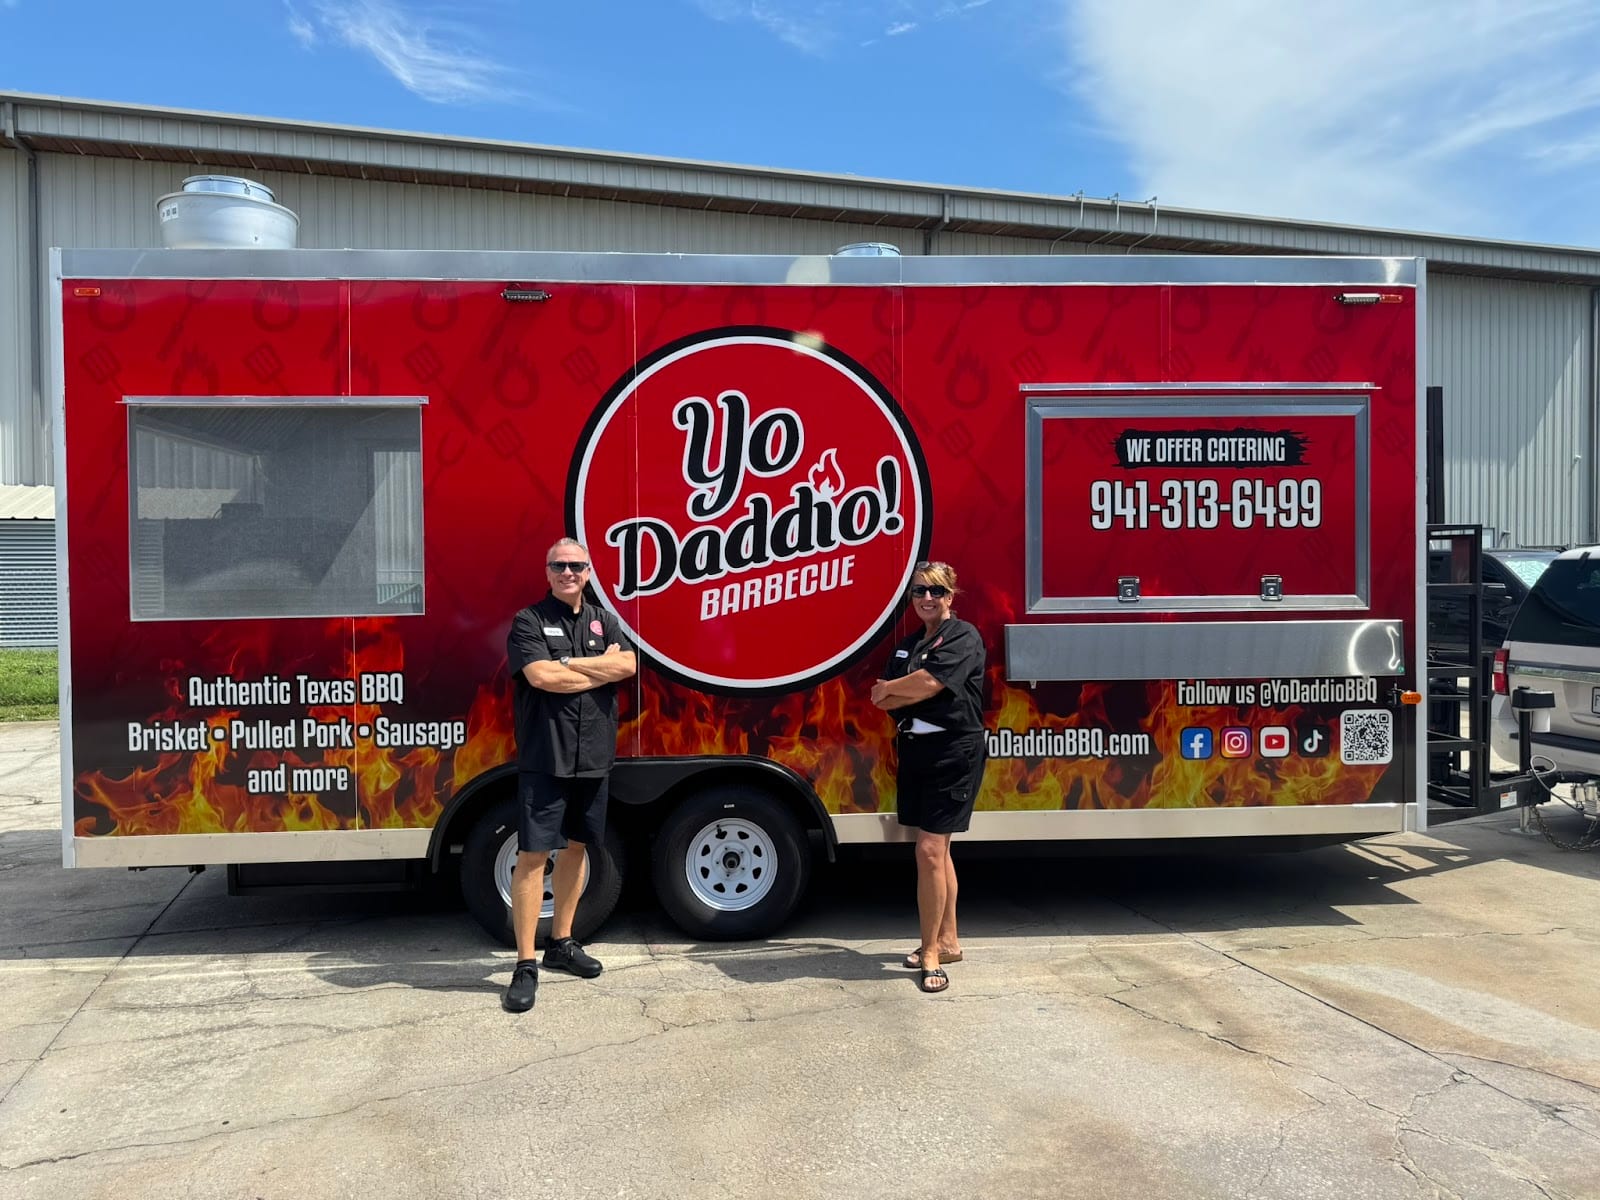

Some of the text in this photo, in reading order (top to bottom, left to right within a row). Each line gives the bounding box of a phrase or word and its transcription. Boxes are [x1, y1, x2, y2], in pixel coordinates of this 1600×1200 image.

[672, 390, 804, 521] Yo
[1126, 437, 1286, 463] WE OFFER CATERING
[1090, 479, 1322, 530] 941-313-6499
[605, 455, 905, 601] Daddio!
[700, 555, 856, 621] BARBECUE
[188, 673, 405, 706] Authentic Texas BBQ
[1178, 678, 1378, 707] Follow us @YoDaddioBBQ
[128, 717, 465, 752] Brisket Pulled Pork Sausage
[248, 762, 349, 793] and more
